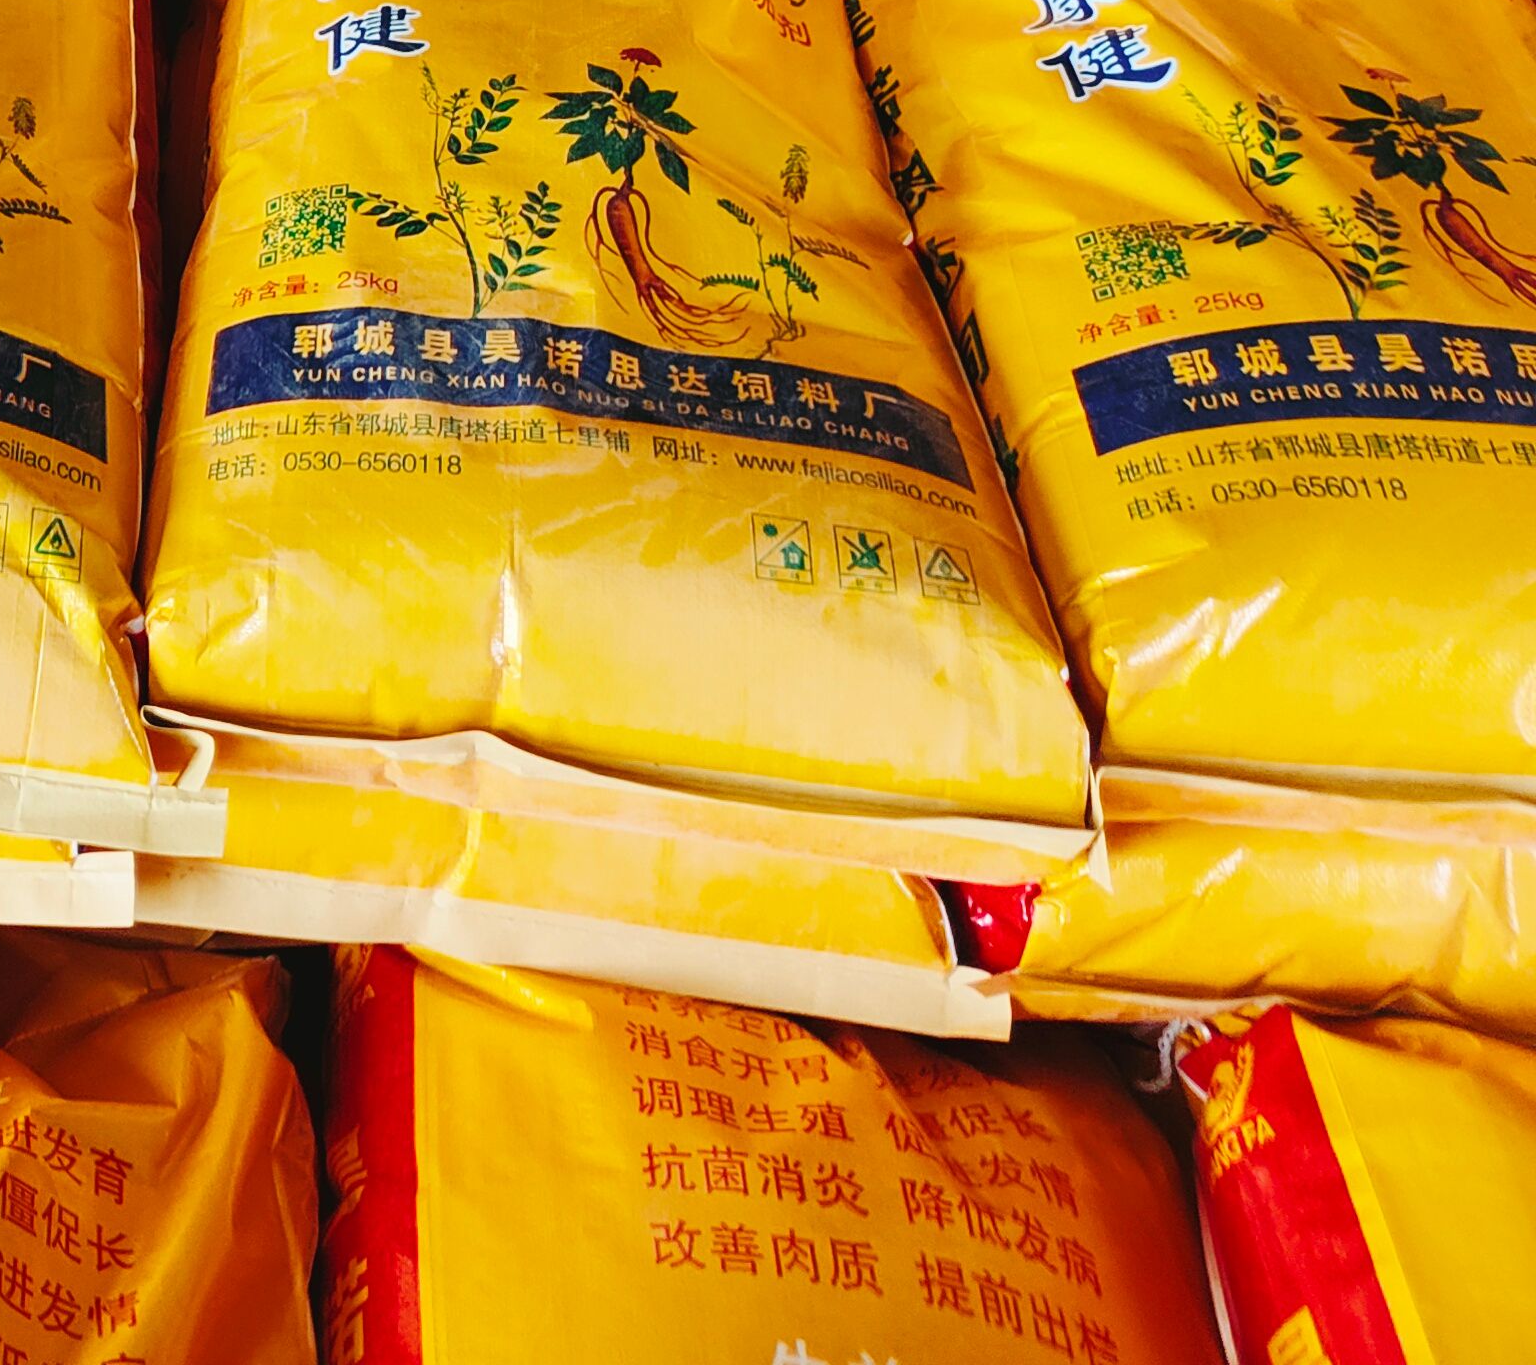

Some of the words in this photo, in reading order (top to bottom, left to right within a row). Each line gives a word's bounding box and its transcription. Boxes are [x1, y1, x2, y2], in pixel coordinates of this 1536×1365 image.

[231, 270, 321, 310] 净含量：
[335, 270, 399, 296] 25kg
[1077, 303, 1178, 344] 净含量：
[1194, 289, 1265, 315] 25kg
[291, 318, 901, 421] 郓城县昊诺思达饲料厂
[1182, 390, 1241, 414] YUN
[1250, 382, 1342, 405] CHENG
[1355, 381, 1421, 401] XIAN
[1431, 385, 1486, 405] HAO
[290, 366, 342, 385] YUN
[351, 365, 434, 386] CHENG
[446, 370, 505, 391] XIAN
[516, 374, 567, 396] HAO
[576, 388, 631, 412] NUO
[641, 396, 666, 415] SI
[677, 401, 711, 421] DA
[720, 407, 744, 425] SI
[754, 410, 814, 434] LIAO
[823, 420, 911, 453] CHANG
[206, 450, 269, 482] 电话：
[282, 448, 462, 478] 0530-6560118
[651, 433, 718, 469] 网址：
[734, 446, 978, 519] www.fajiaosiliao.com
[1126, 487, 1197, 522] 电话：
[1211, 477, 1408, 505] 0530-6560118
[624, 1021, 829, 1087] 消食开胃
[632, 1075, 855, 1143] 调理生殖
[641, 1143, 869, 1218] 抗菌消炎
[899, 1176, 1102, 1298] 降低发病
[650, 1218, 883, 1297] 改善肉质
[915, 1251, 1119, 1365] 提前出栏
